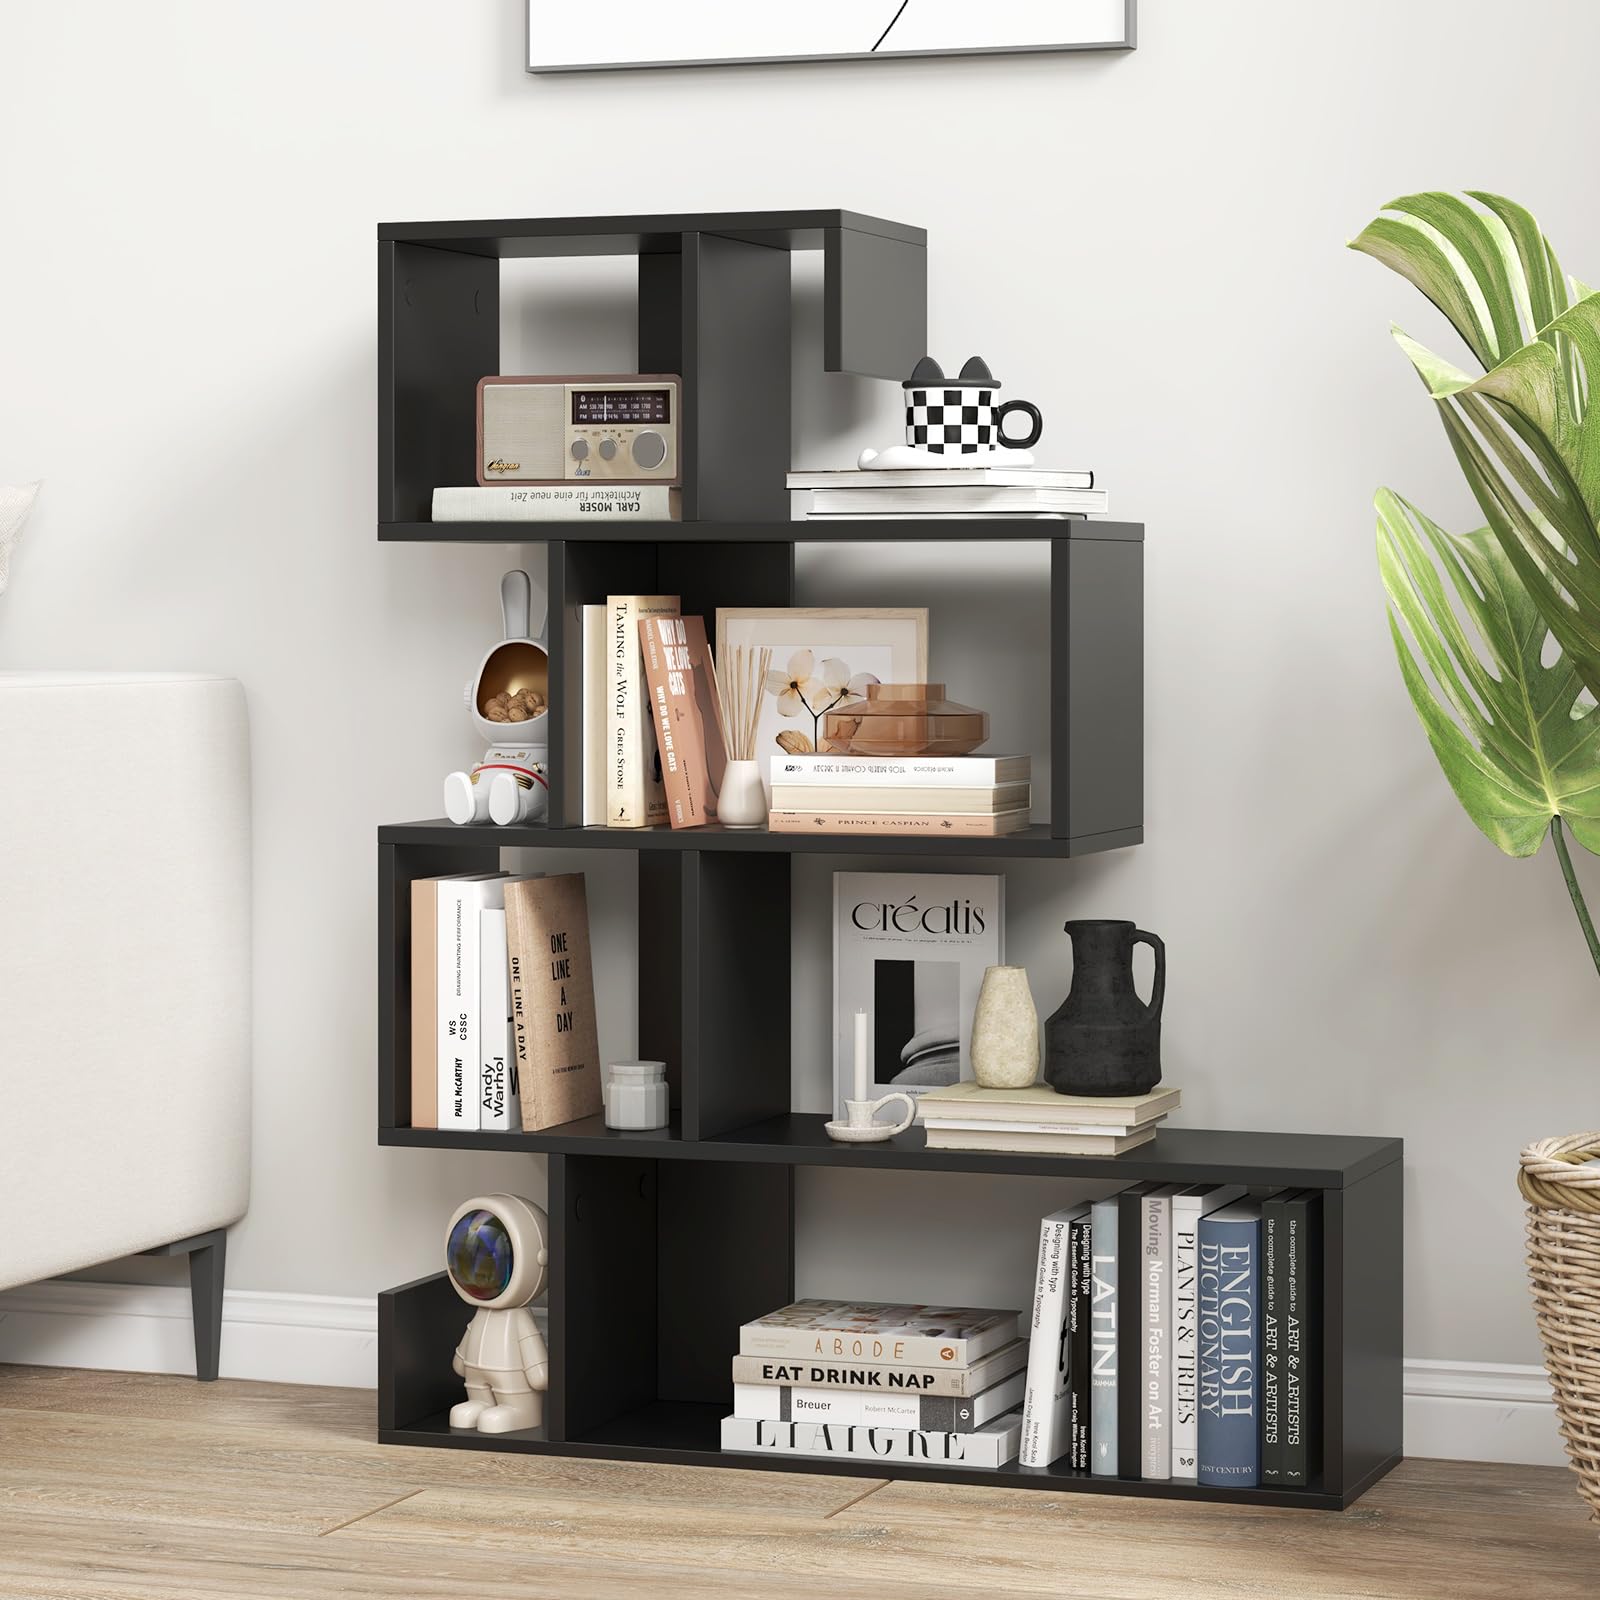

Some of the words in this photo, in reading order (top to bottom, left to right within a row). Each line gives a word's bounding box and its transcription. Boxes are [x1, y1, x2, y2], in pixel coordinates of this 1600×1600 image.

[511, 492, 528, 502] Zeit
[554, 491, 573, 502] eine
[576, 491, 588, 502] für
[580, 502, 612, 512] MOSER
[591, 491, 640, 501] Architektur
[616, 502, 640, 512] CARL
[616, 603, 628, 659] TAMING
[616, 662, 625, 677] the
[616, 680, 628, 719] WOLF
[656, 685, 666, 704] WHY
[660, 705, 668, 717] DO
[662, 717, 671, 731] WE
[617, 728, 626, 756] GREG
[664, 731, 674, 750] LOVE
[667, 751, 677, 772] CATS
[617, 758, 626, 790] STONE
[852, 895, 985, 935] créatis
[550, 932, 568, 954] ONE
[512, 957, 520, 983] ONE
[551, 958, 571, 981] LINE
[514, 988, 524, 1018] LINE
[560, 986, 567, 1006] A
[448, 1020, 457, 1036] WS
[460, 1013, 468, 1041] CSSC
[517, 1023, 524, 1032] A
[556, 1012, 573, 1033] DAY
[518, 1035, 527, 1061] DAY
[454, 1057, 464, 1097] McCARTHY
[482, 1064, 496, 1110] Andy
[493, 1056, 504, 1118] Warhol
[454, 1098, 463, 1118] PAUL
[1146, 1200, 1162, 1256] Moving
[1041, 1238, 1049, 1267] Essential
[1050, 1224, 1064, 1260] Designing
[1081, 1224, 1092, 1260] Designing
[1266, 1235, 1275, 1275] complete
[1288, 1236, 1297, 1276] complete
[1050, 1261, 1060, 1279] with
[1082, 1262, 1092, 1278] with
[1178, 1232, 1194, 1320] PLANTS
[1038, 1284, 1044, 1293] to
[1048, 1279, 1058, 1293] type
[1072, 1287, 1078, 1296] to
[1081, 1279, 1090, 1295] type
[1149, 1260, 1163, 1323] Norman
[1266, 1276, 1275, 1300] guide
[1288, 1276, 1297, 1302] guide
[1034, 1294, 1044, 1328] Typography
[1070, 1296, 1078, 1333] Typography
[1092, 1256, 1116, 1376] LATIN
[1268, 1301, 1275, 1311] to
[1290, 1302, 1297, 1312] to
[1178, 1326, 1194, 1343] &
[1200, 1243, 1220, 1418] DICTIONARY
[1220, 1243, 1253, 1418] ENGLISH
[1266, 1313, 1278, 1350] ART
[1288, 1314, 1300, 1352] ART
[814, 1338, 904, 1360] ABODE
[1148, 1327, 1163, 1377] Foster
[1266, 1354, 1278, 1368] &
[1288, 1354, 1300, 1370] &
[762, 1364, 803, 1381] EAT
[811, 1368, 882, 1386] DRINK
[888, 1372, 935, 1390] NAP
[1178, 1350, 1195, 1424] TREES
[1148, 1381, 1160, 1400] on
[796, 1399, 832, 1410] Breuer
[864, 1404, 886, 1414] Robert
[888, 1406, 916, 1414] McCarter
[1148, 1404, 1163, 1430] Art
[1266, 1370, 1278, 1444] ARTISTS
[1288, 1372, 1300, 1445] ARTISTS
[1201, 1464, 1216, 1473] 21ST
[1216, 1466, 1254, 1474] CENTURY
